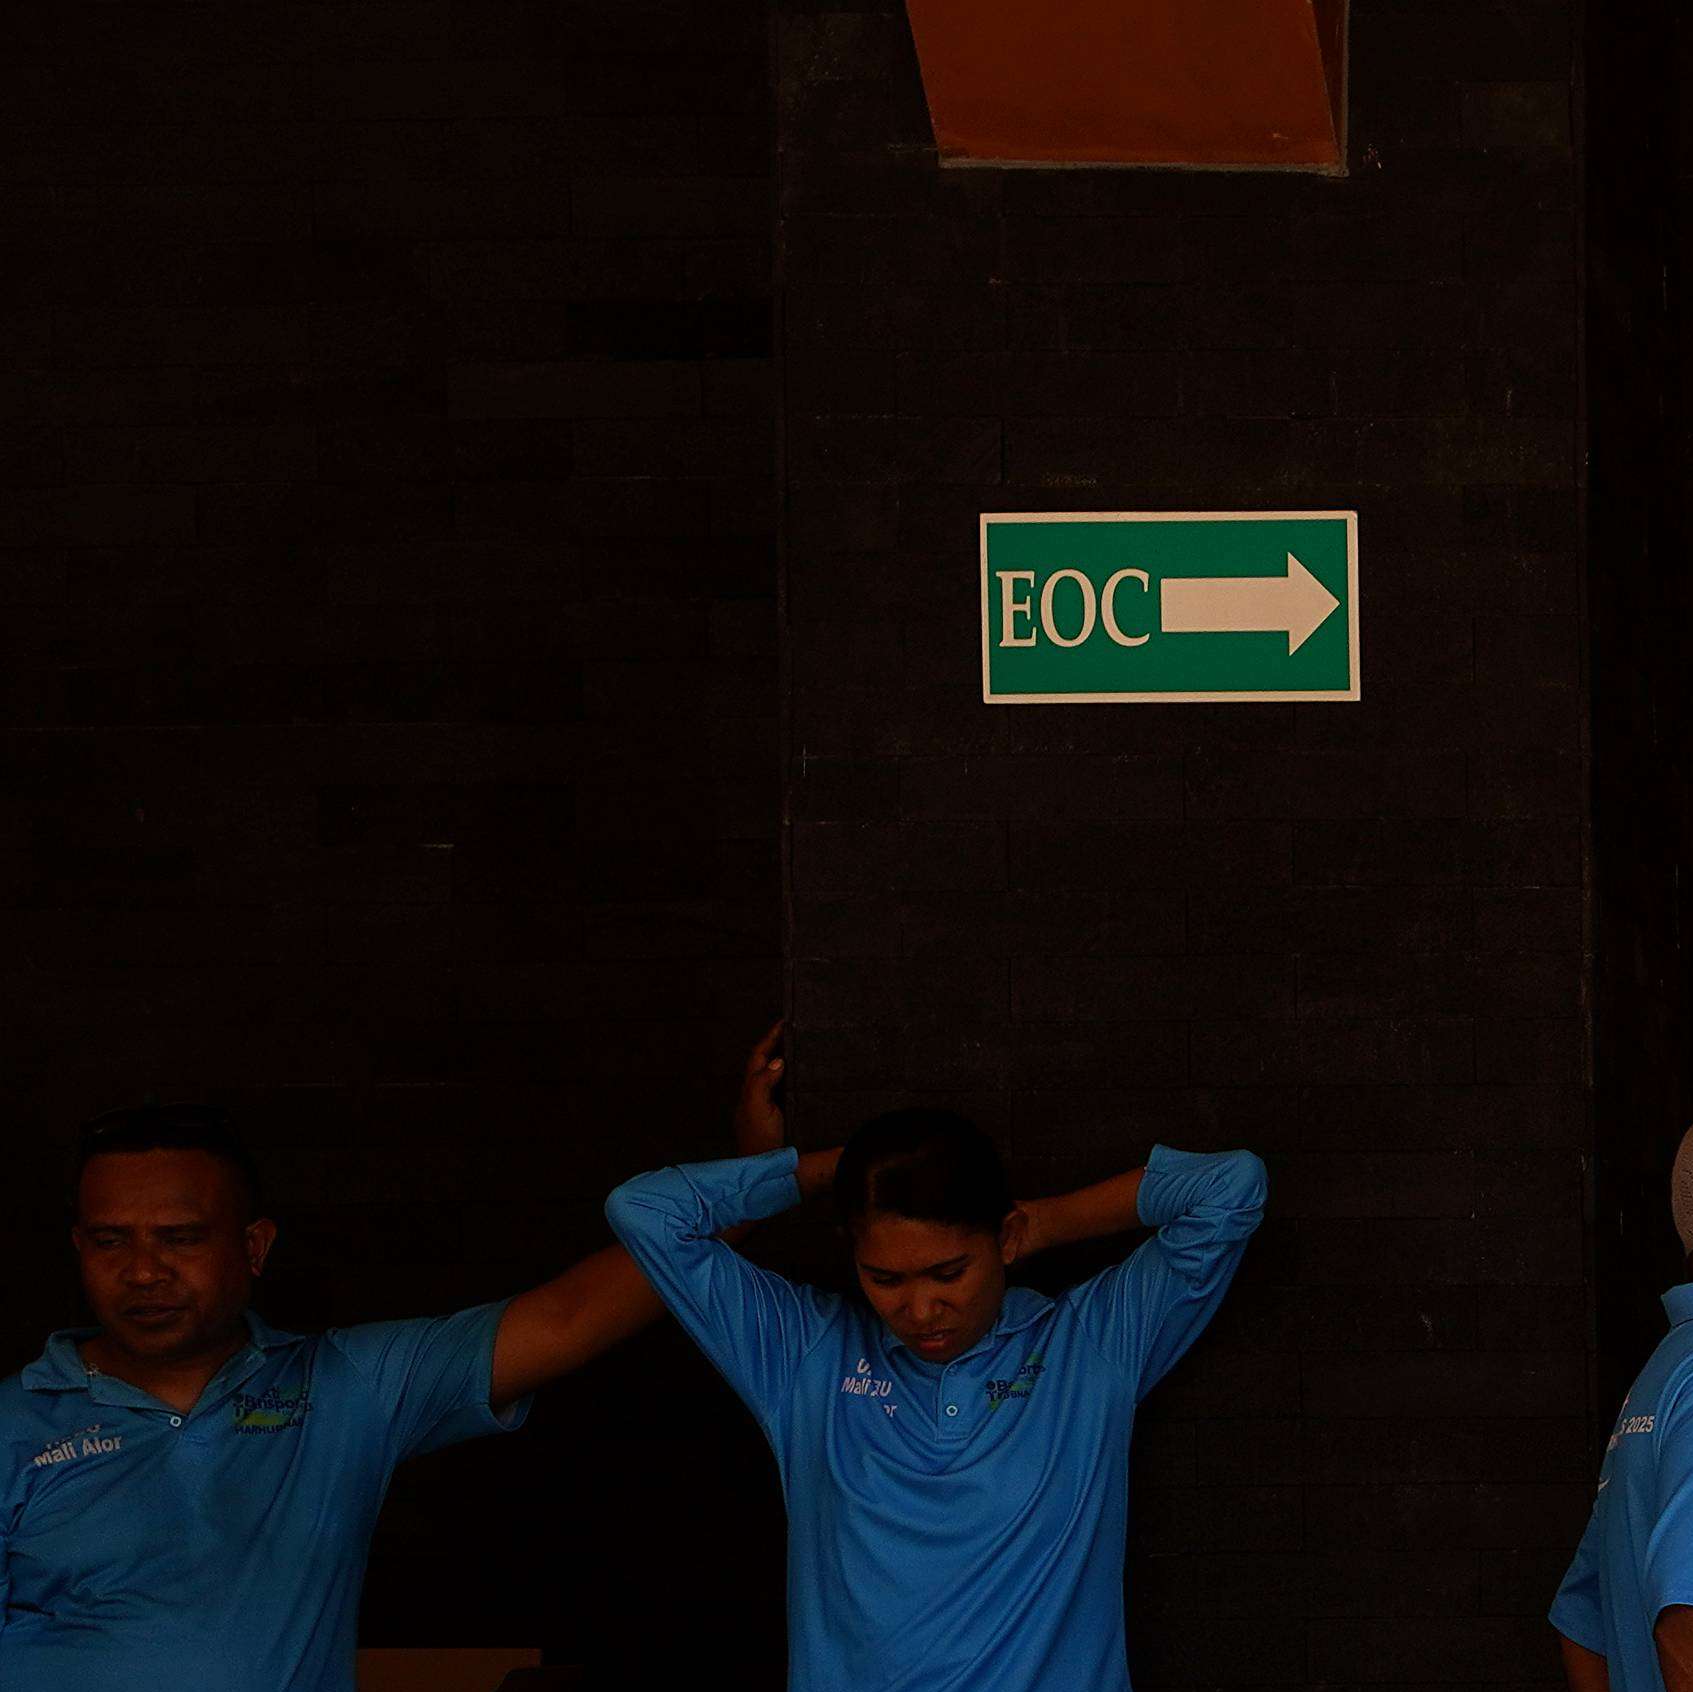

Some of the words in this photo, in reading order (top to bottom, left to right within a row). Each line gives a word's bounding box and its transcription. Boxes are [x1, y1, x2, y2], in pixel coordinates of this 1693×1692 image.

[995, 568, 1151, 648] EOC
[1625, 1415, 1655, 1434] 2025
[82, 1435, 122, 1457] Alor
